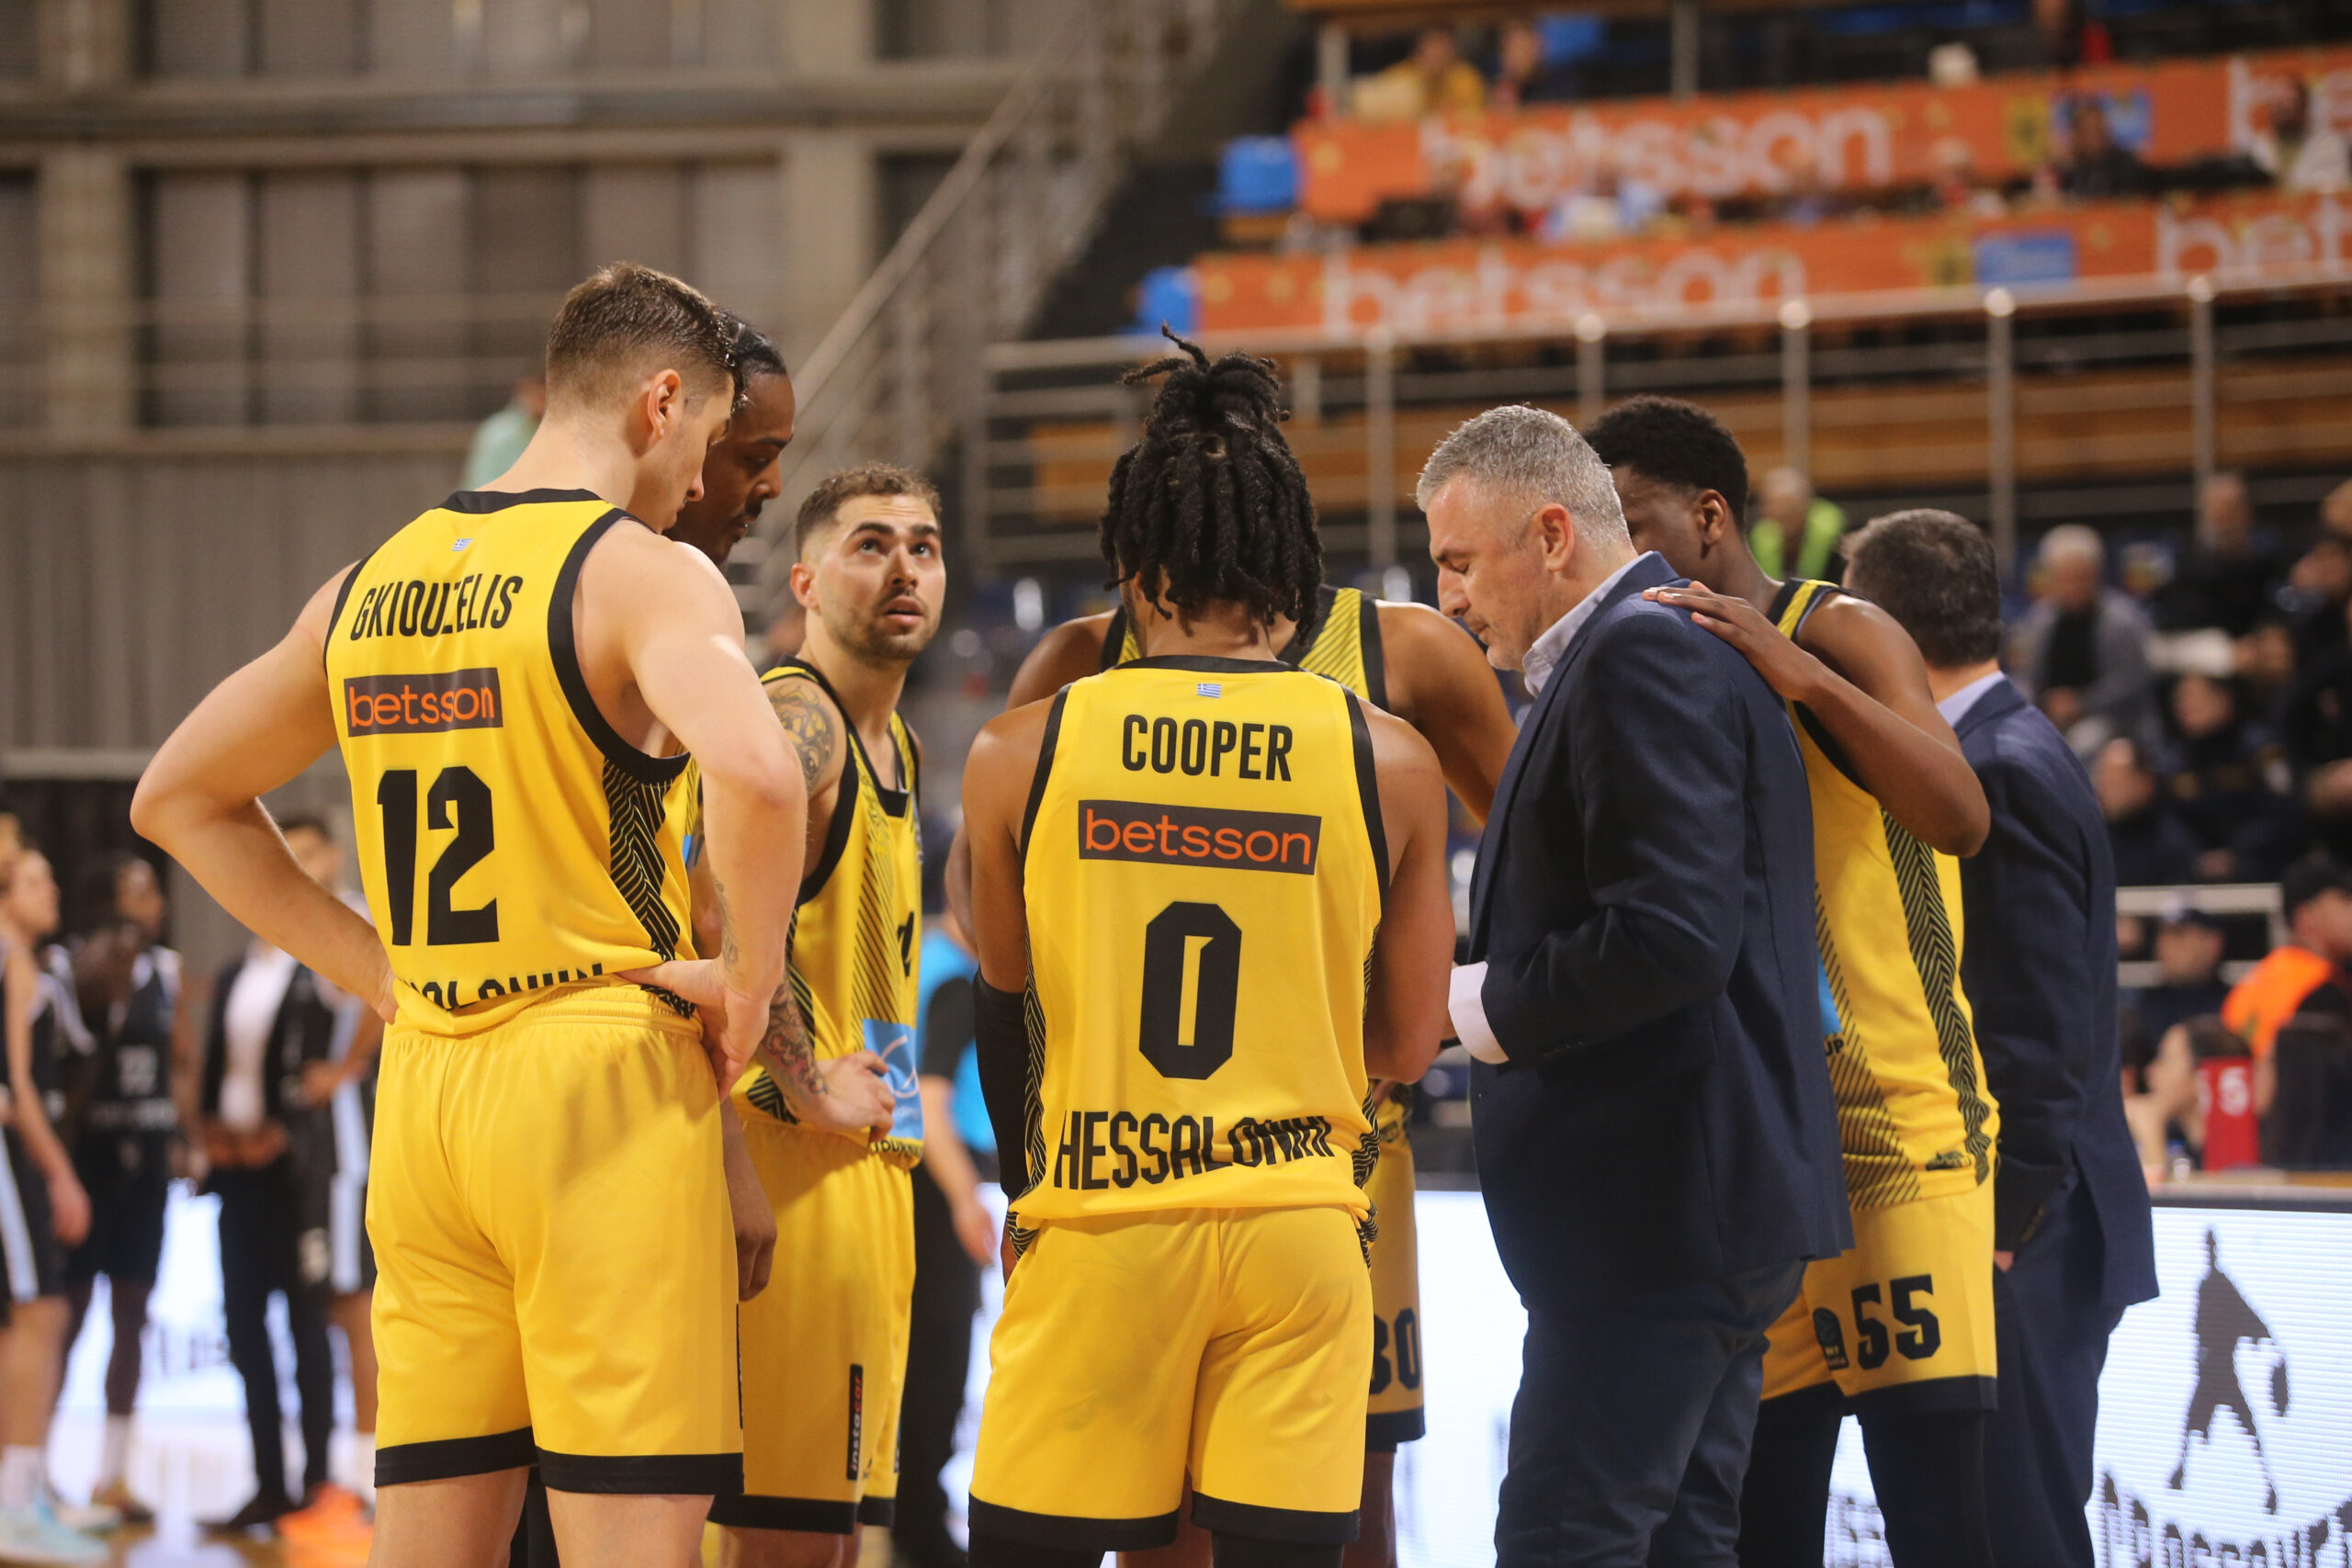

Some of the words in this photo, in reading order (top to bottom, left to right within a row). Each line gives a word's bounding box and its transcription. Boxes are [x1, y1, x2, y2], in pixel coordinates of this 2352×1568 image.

[1323, 244, 1807, 338] betsson
[349, 684, 495, 728] betsson
[1122, 714, 1294, 782] COOPER
[377, 765, 500, 946] 12
[1085, 807, 1312, 865] betsson
[1138, 901, 1242, 1080] 0
[1851, 1273, 1941, 1370] 55
